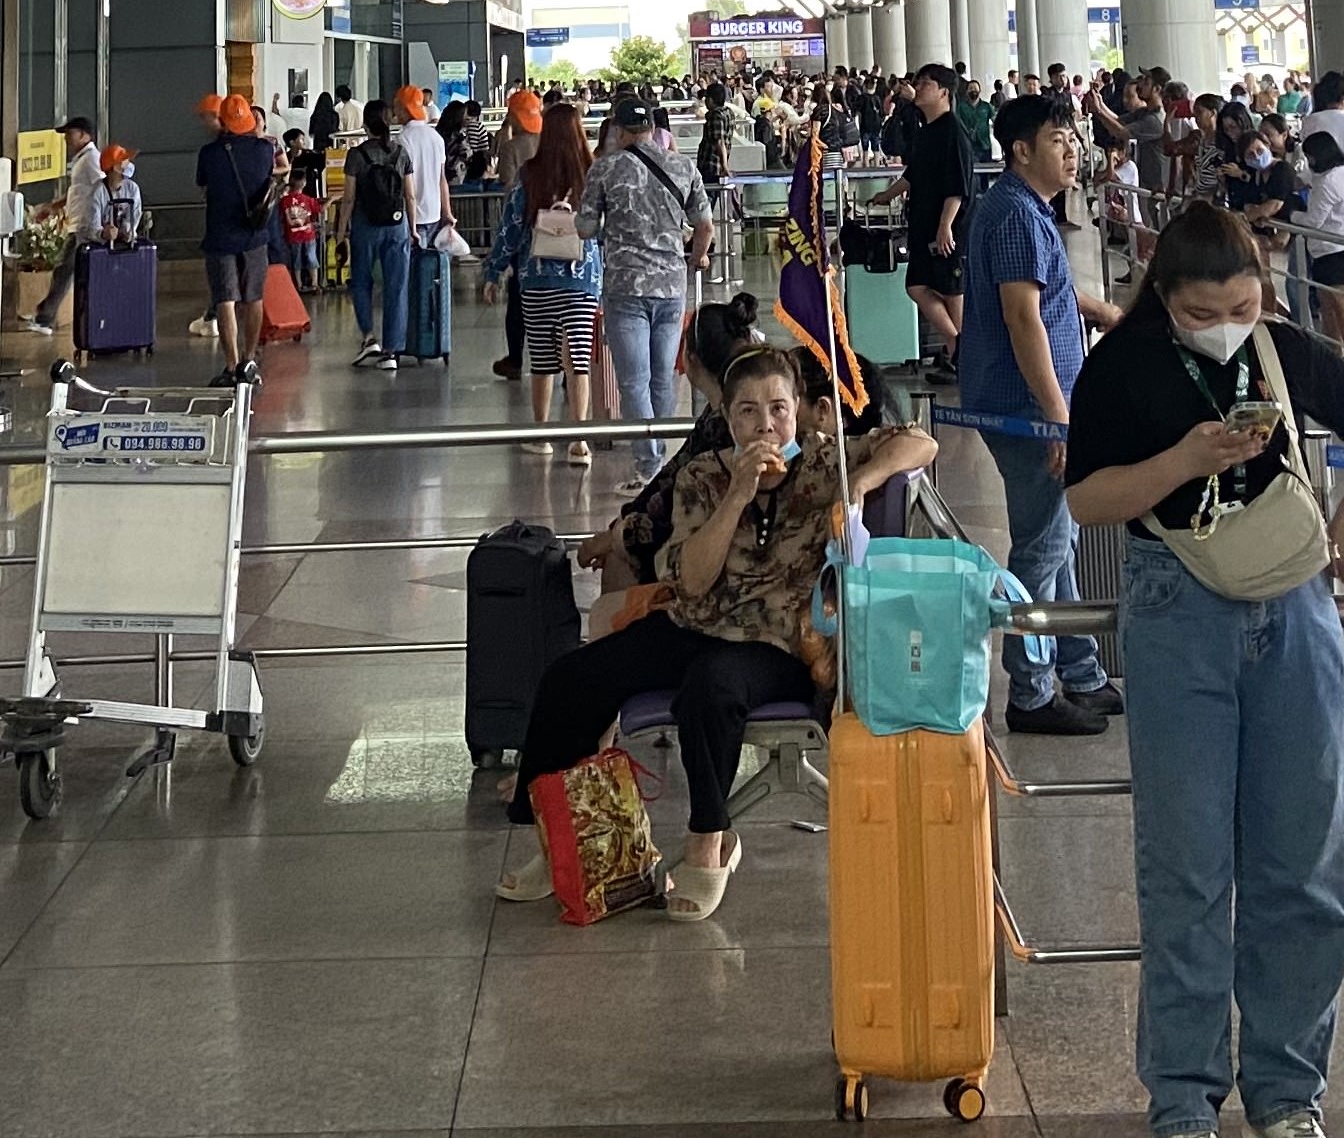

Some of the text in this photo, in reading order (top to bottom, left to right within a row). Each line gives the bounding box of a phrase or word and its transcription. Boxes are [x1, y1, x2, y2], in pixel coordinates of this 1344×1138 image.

[710, 20, 804, 36] BURGER KING
[786, 218, 816, 266] ZING
[1029, 422, 1062, 438] TIA
